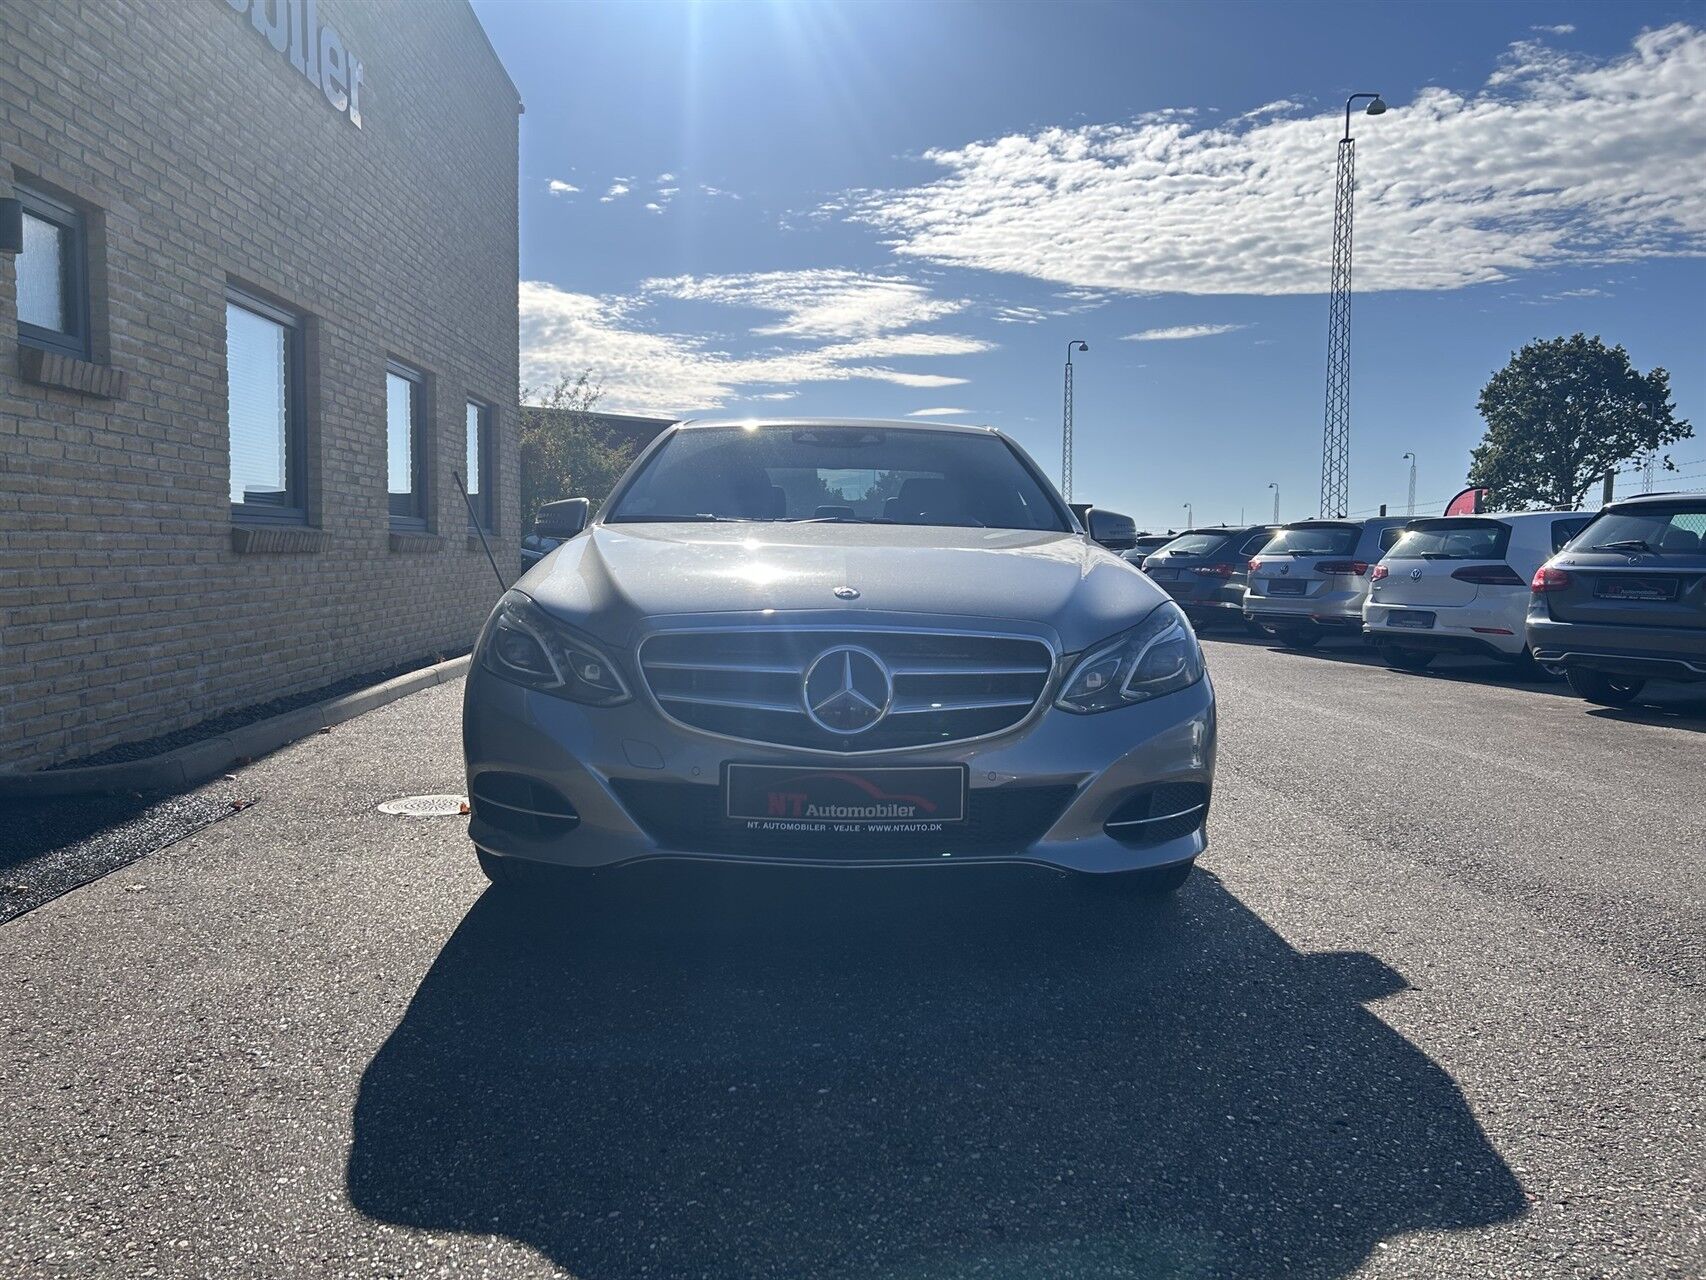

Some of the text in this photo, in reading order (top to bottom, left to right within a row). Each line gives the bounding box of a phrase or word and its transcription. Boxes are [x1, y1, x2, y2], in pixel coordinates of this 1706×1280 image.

[224, 0, 364, 130] iler
[768, 792, 916, 817] NT Automobiler
[747, 821, 942, 832] NT. AUTOMOBILER VEJLE WWW.NTAUTO.DK
